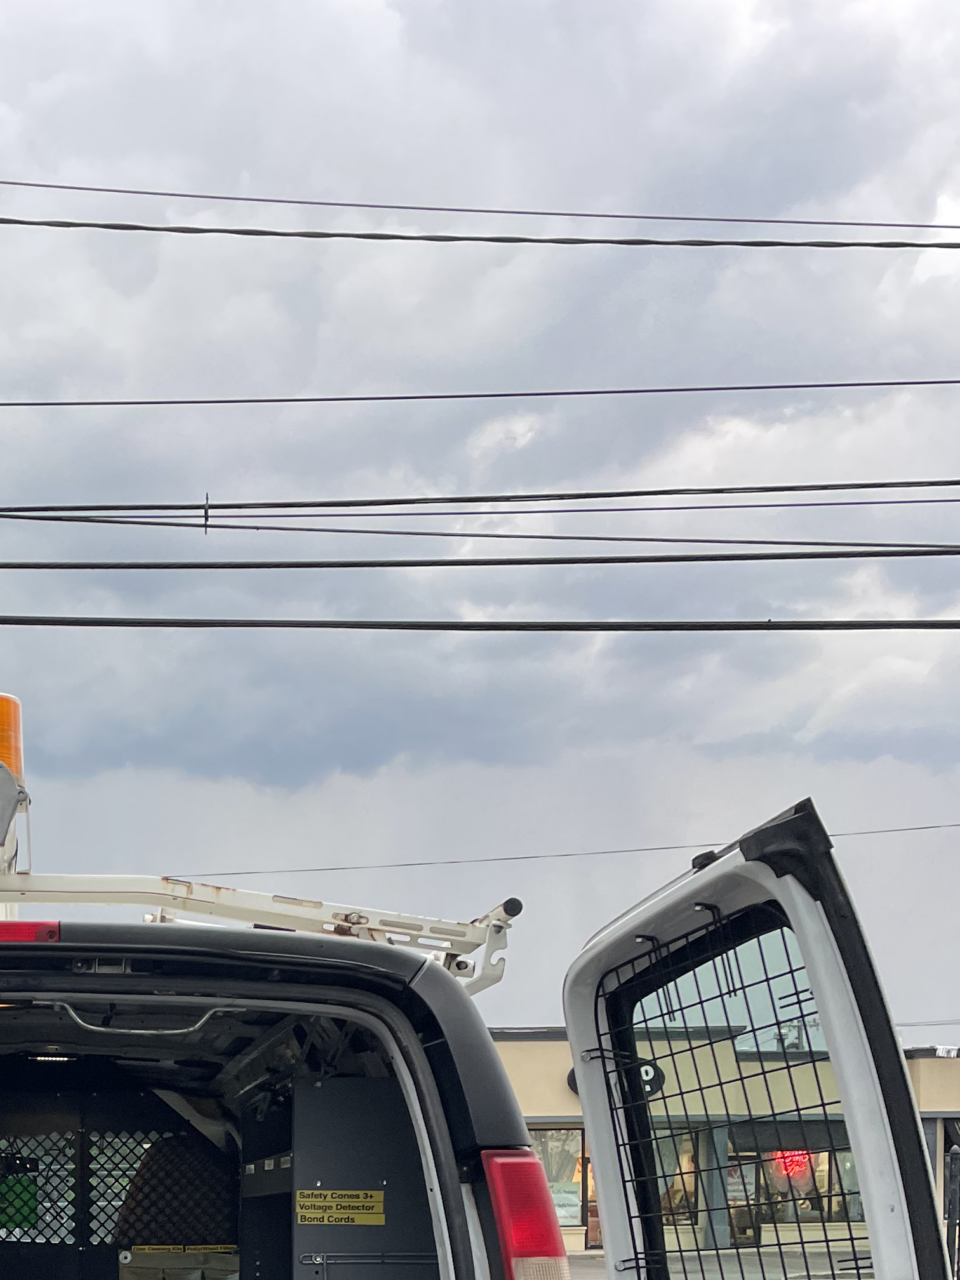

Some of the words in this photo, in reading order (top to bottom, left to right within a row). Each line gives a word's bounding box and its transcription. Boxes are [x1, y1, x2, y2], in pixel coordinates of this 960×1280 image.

[299, 1191, 328, 1201] Safety
[330, 1192, 360, 1200] Cones
[363, 1192, 375, 1200] 3+
[299, 1203, 333, 1212] Voltage
[336, 1203, 375, 1211] Detector
[300, 1214, 325, 1223] Bond
[327, 1215, 355, 1224] Cords
